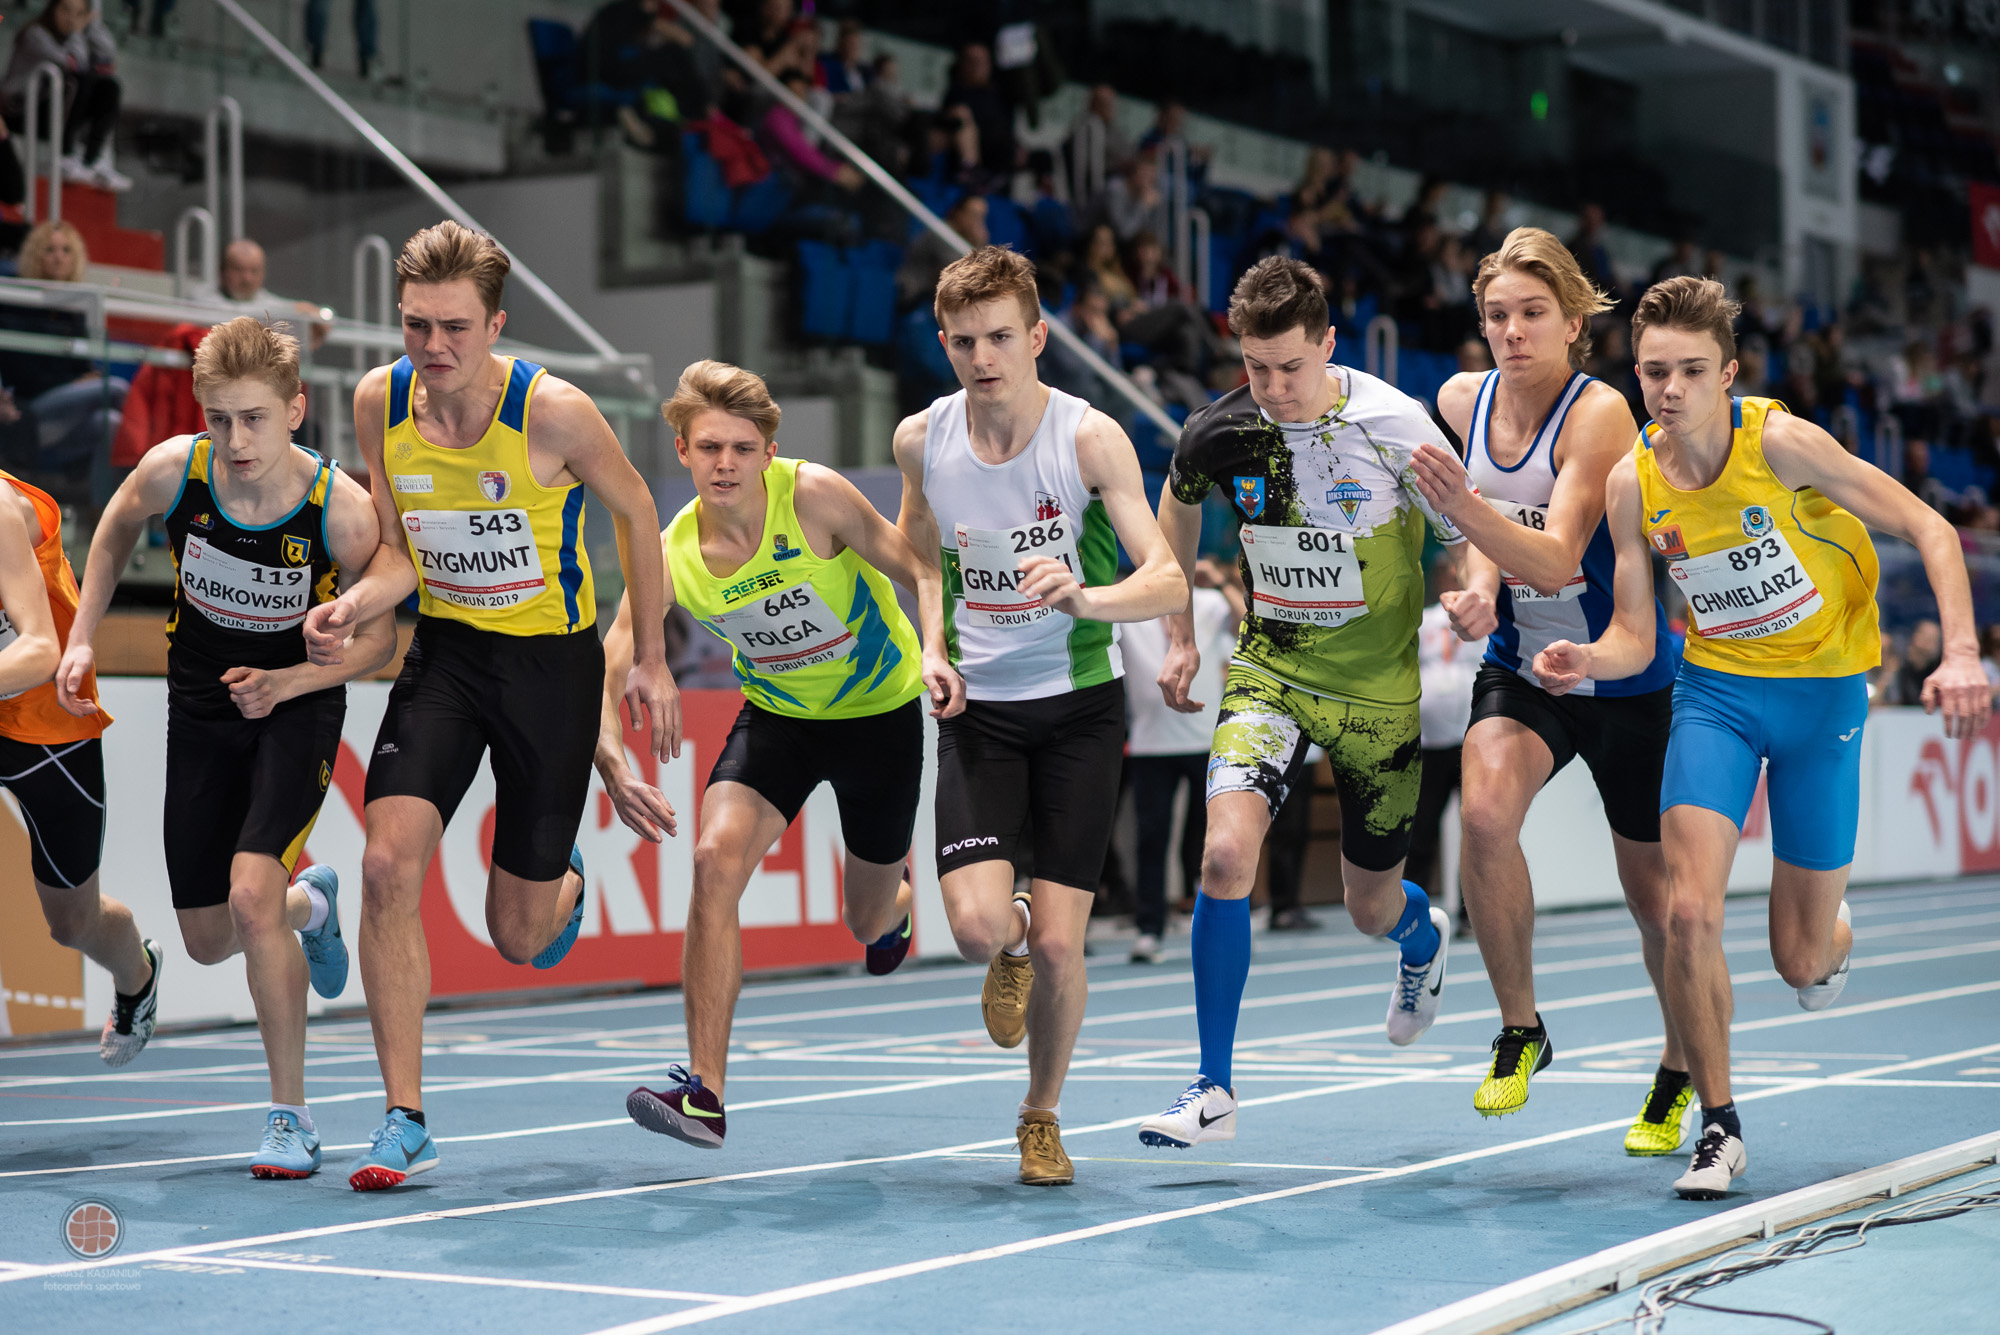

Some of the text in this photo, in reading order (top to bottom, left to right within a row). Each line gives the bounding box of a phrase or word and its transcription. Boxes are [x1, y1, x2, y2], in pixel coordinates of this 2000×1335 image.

[1327, 489, 1371, 502] MKS ŻYWIEC
[469, 513, 522, 536] 543
[1517, 508, 1546, 531] 18
[1010, 520, 1065, 554] 286
[1297, 531, 1347, 553] 801
[1653, 530, 1681, 550] BM
[416, 545, 530, 574] ZYGMUNT
[1727, 537, 1781, 572] 893
[251, 567, 304, 586] 119
[721, 572, 785, 601] PREFBET
[1259, 562, 1343, 589] HUTNY
[184, 571, 303, 610] RĄBKOWSKI
[447, 593, 519, 606] TORUŃ 2019
[1691, 564, 1804, 615] CHMIELARZ
[764, 588, 811, 617] 645
[1273, 607, 1342, 621] TORUŃ 2019
[204, 609, 245, 629] TORUŃ
[249, 622, 280, 631] 2019
[989, 606, 1056, 625] TORUŃ 201
[1727, 612, 1799, 639] TORUŃ 2019
[741, 619, 823, 648] FOLGA
[769, 651, 834, 672] TORUŃ 2019
[942, 836, 999, 857] GIVOVA
